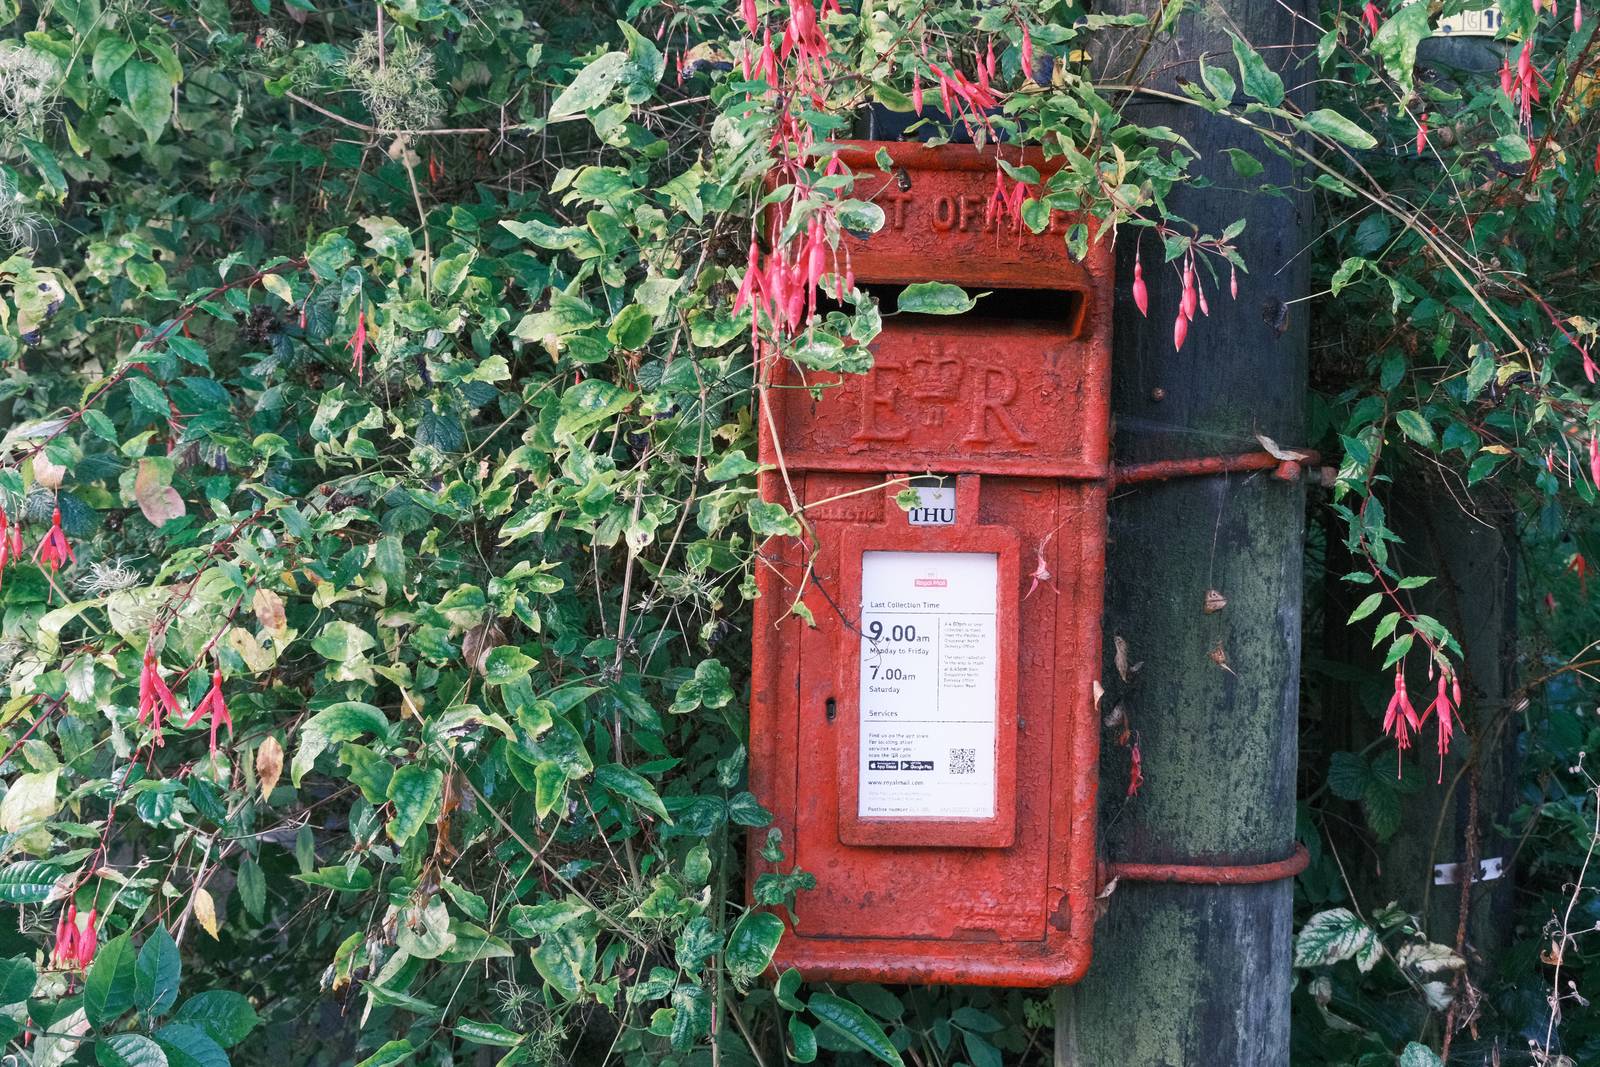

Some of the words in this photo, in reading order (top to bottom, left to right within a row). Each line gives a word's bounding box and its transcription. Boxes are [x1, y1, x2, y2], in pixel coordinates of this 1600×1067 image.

[911, 507, 955, 523] THU
[869, 620, 930, 642] 9.00am
[869, 647, 896, 655] Monday
[908, 647, 929, 655] Friday
[869, 665, 916, 680] 7.00am
[869, 686, 900, 694] Saturday
